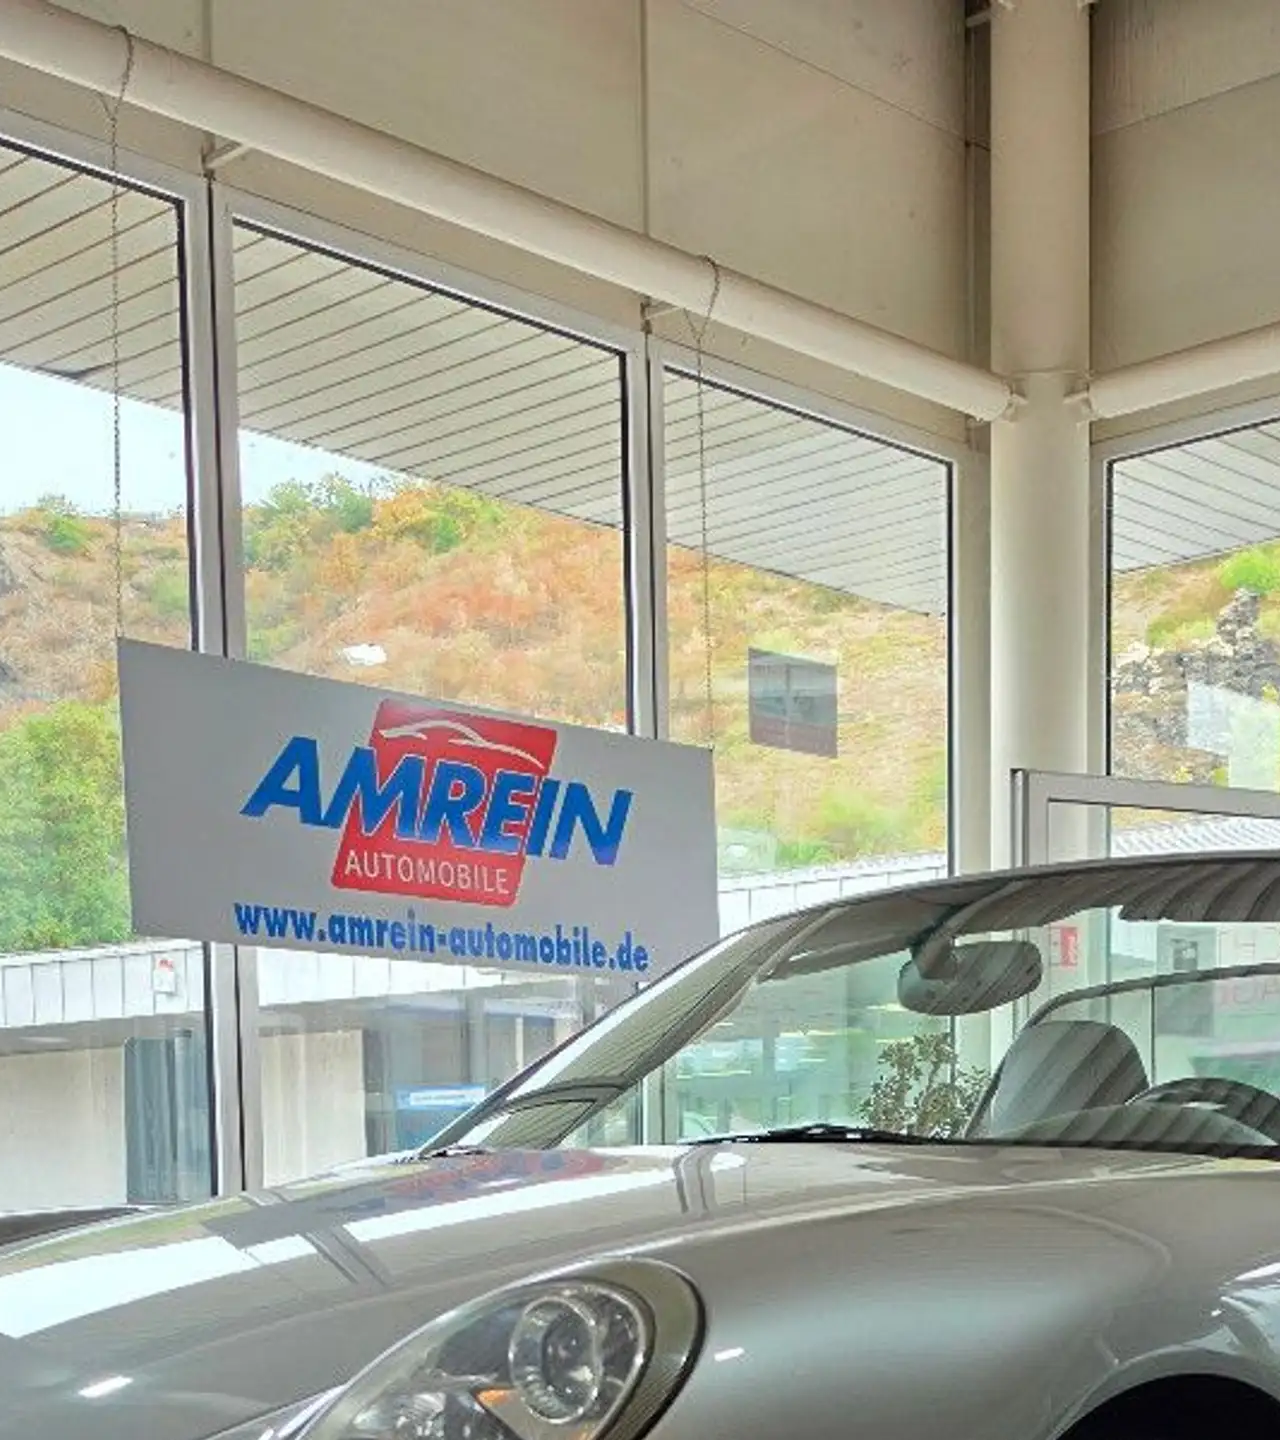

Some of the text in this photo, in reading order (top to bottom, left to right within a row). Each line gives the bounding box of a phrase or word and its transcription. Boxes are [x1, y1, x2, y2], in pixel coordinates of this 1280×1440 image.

[240, 735, 634, 866] AMREIN
[344, 849, 510, 895] AUTOMOBILE
[233, 901, 649, 974] www.amrein-automobile.de
